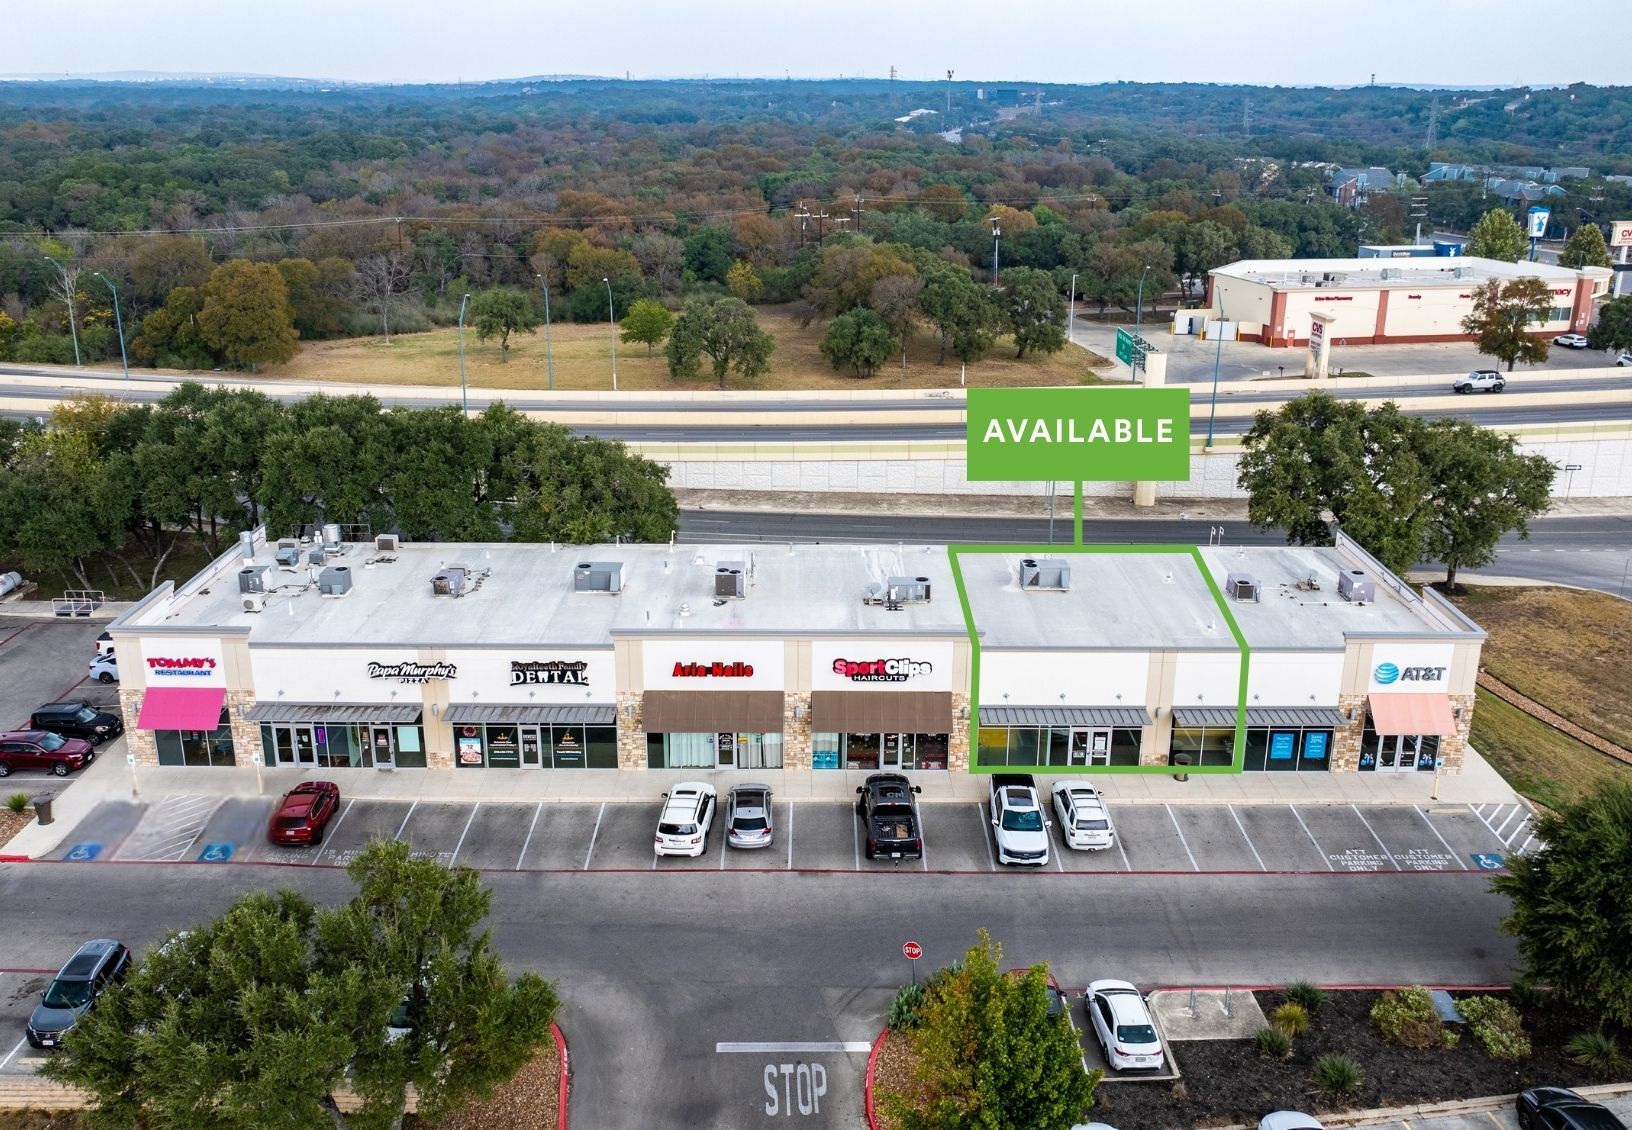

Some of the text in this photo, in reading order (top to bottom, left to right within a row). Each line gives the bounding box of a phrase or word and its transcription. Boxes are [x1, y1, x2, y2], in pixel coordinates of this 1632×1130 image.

[1312, 322, 1323, 335] CVS
[147, 657, 216, 669] TOMMY'S
[558, 661, 588, 672] Family
[368, 662, 457, 680] Papa Murphy's
[1401, 667, 1446, 681] AT&T
[905, 946, 920, 954] STOP
[764, 1063, 827, 1116] STOP
